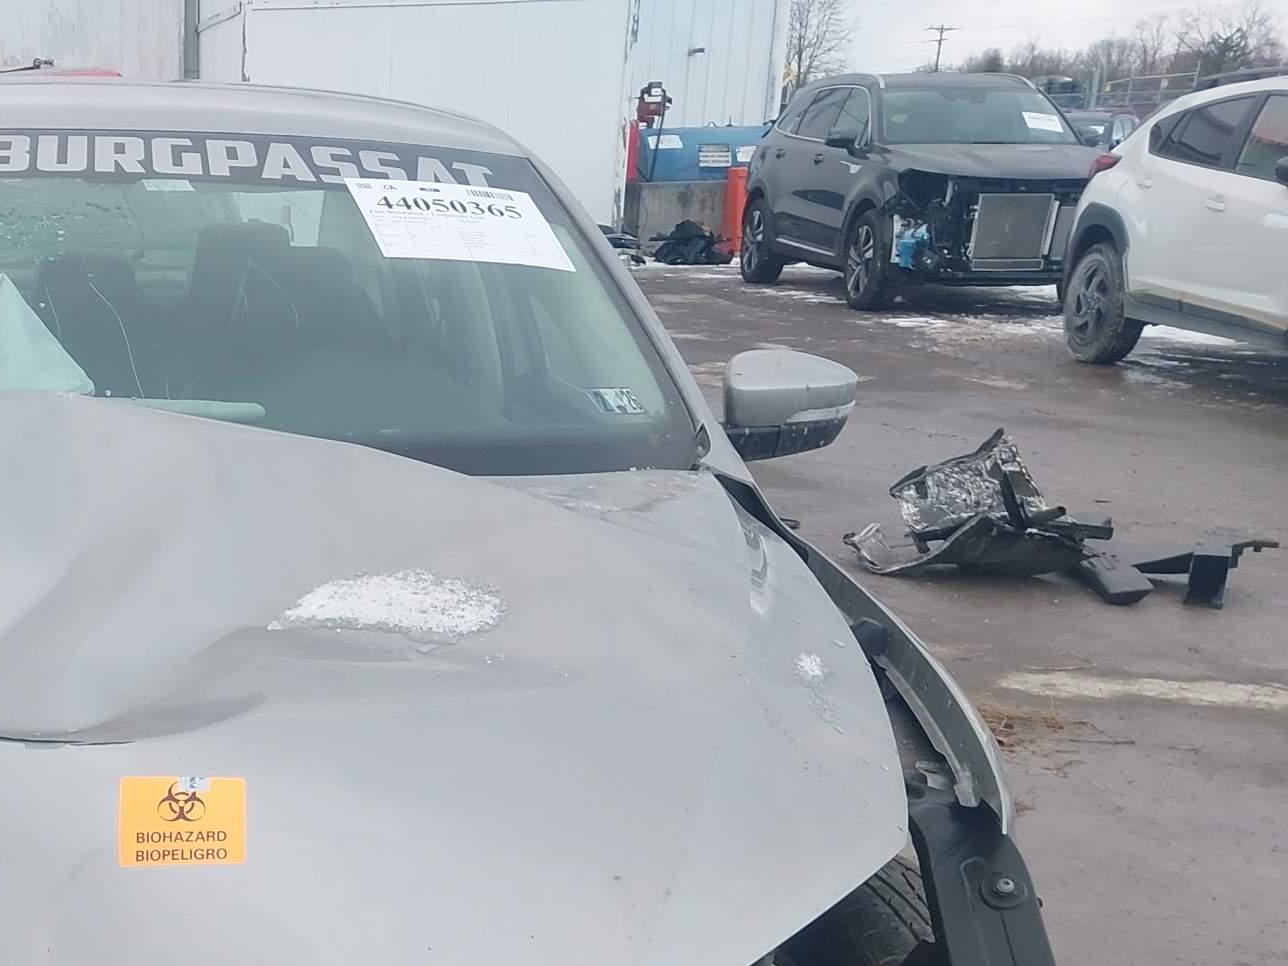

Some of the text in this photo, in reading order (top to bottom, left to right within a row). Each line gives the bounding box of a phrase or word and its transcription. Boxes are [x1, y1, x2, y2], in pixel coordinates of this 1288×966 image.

[377, 195, 523, 220] 44050365
[136, 831, 227, 843] BIOHAZARD
[135, 848, 227, 861] BIOPELIGRO
